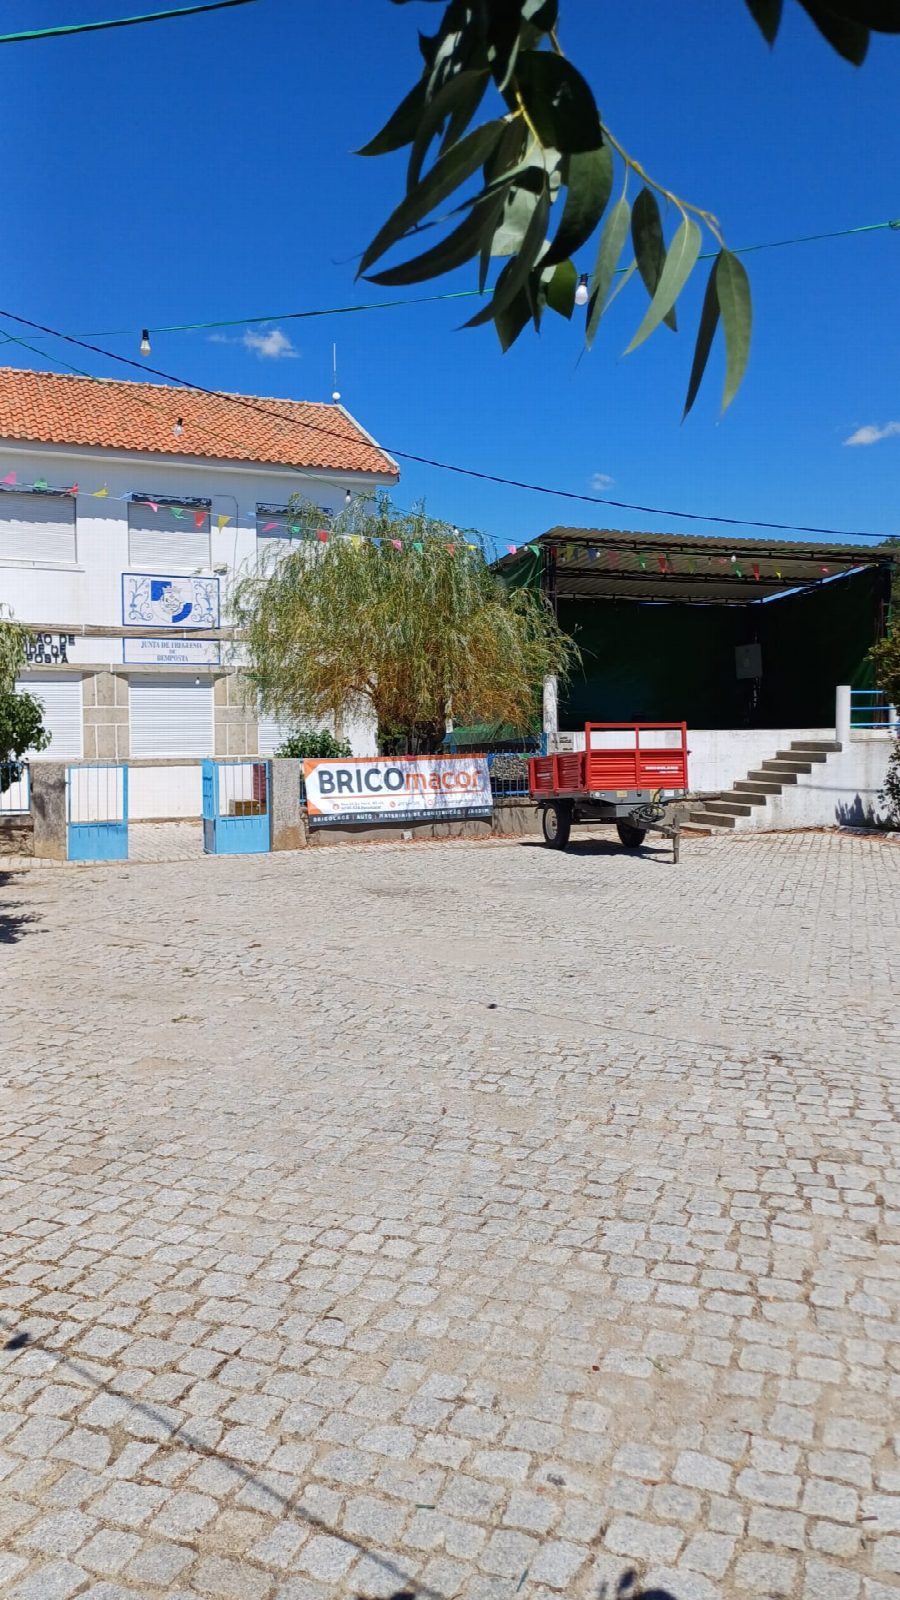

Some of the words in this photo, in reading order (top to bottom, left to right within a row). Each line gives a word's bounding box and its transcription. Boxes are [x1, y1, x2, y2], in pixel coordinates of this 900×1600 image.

[60, 634, 75, 646] DE
[161, 641, 169, 649] DE
[51, 644, 67, 656] DE
[26, 653, 69, 664] POSTA
[313, 814, 350, 822] BRICOLAGE
